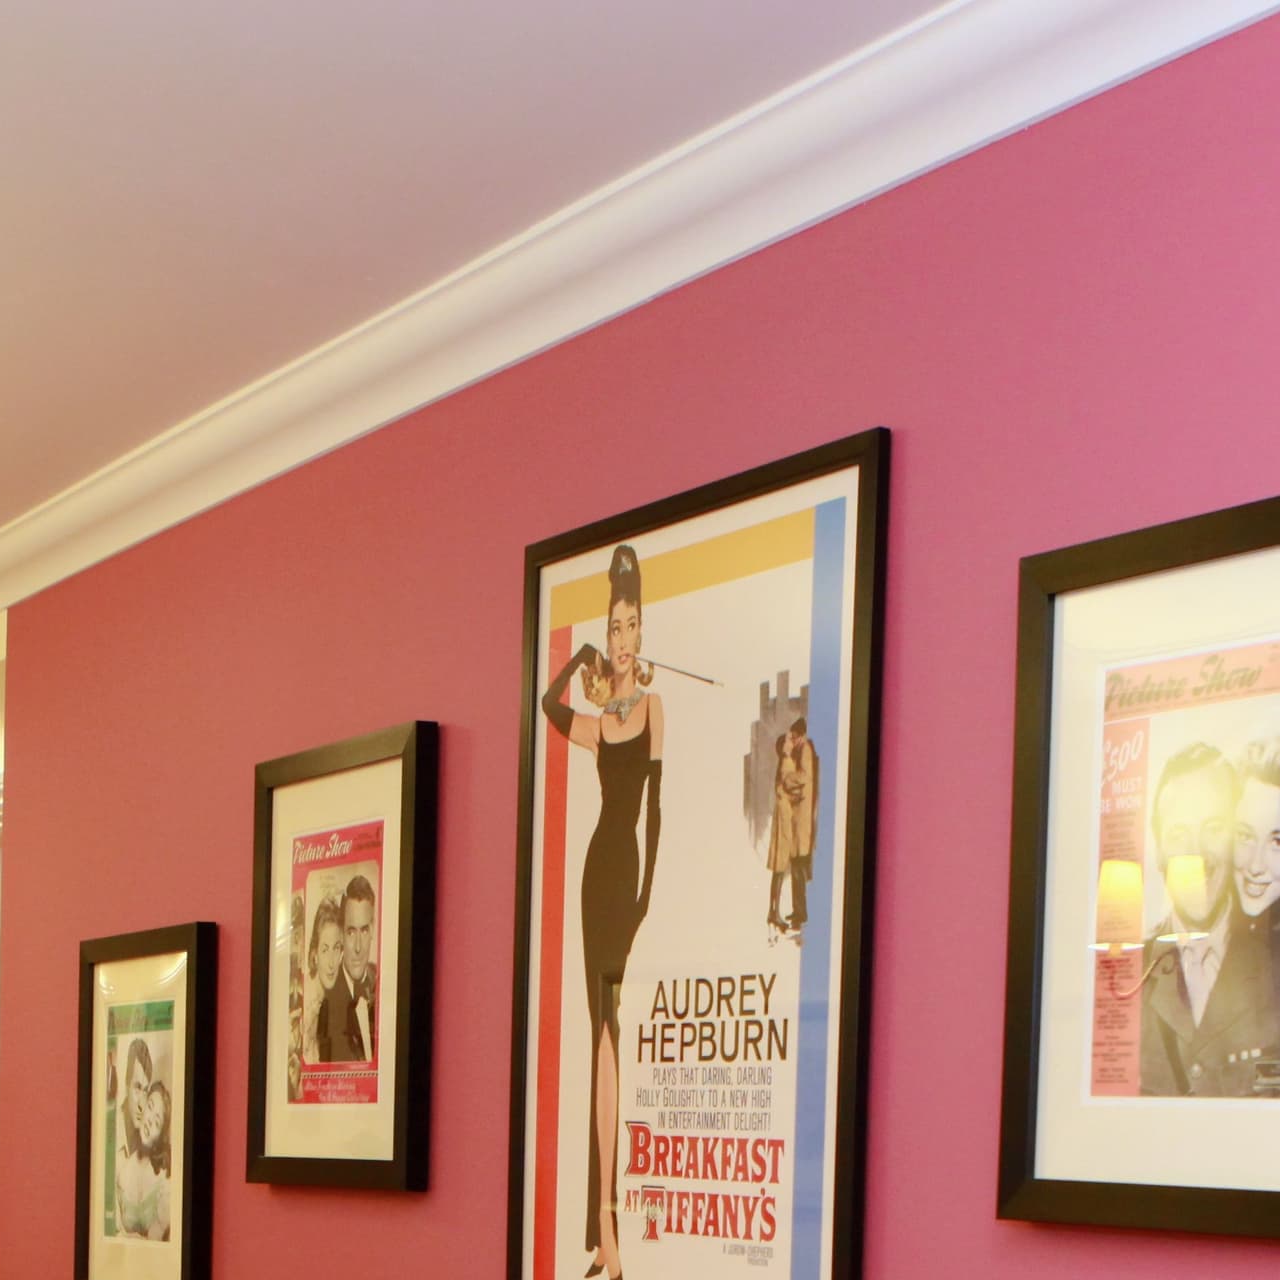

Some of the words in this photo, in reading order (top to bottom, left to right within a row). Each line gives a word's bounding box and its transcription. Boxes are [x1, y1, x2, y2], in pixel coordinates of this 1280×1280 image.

[1104, 672, 1188, 712] Picture
[1191, 655, 1264, 697] Show
[293, 840, 325, 864] Picture
[325, 832, 353, 858] Show
[650, 973, 777, 1021] AUDREY
[637, 1018, 788, 1063] HEPBURN
[636, 1088, 660, 1106] HOLLY
[663, 1088, 705, 1107] GOLIGHTLY
[708, 1089, 718, 1107] TO
[721, 1090, 726, 1107] A
[729, 1090, 748, 1108] NEW
[751, 1089, 771, 1108] HIGH
[652, 1067, 677, 1085] PLAYS
[680, 1067, 699, 1085] THAT
[736, 1067, 772, 1086] DARLING
[658, 1112, 666, 1128] IN
[668, 1112, 731, 1130] ENTERTAINMENT
[734, 1112, 771, 1131] DELIGHT!
[625, 1121, 785, 1184] BREAKFAST
[624, 1189, 640, 1213] AT
[641, 1185, 777, 1242] TIFFANY'S
